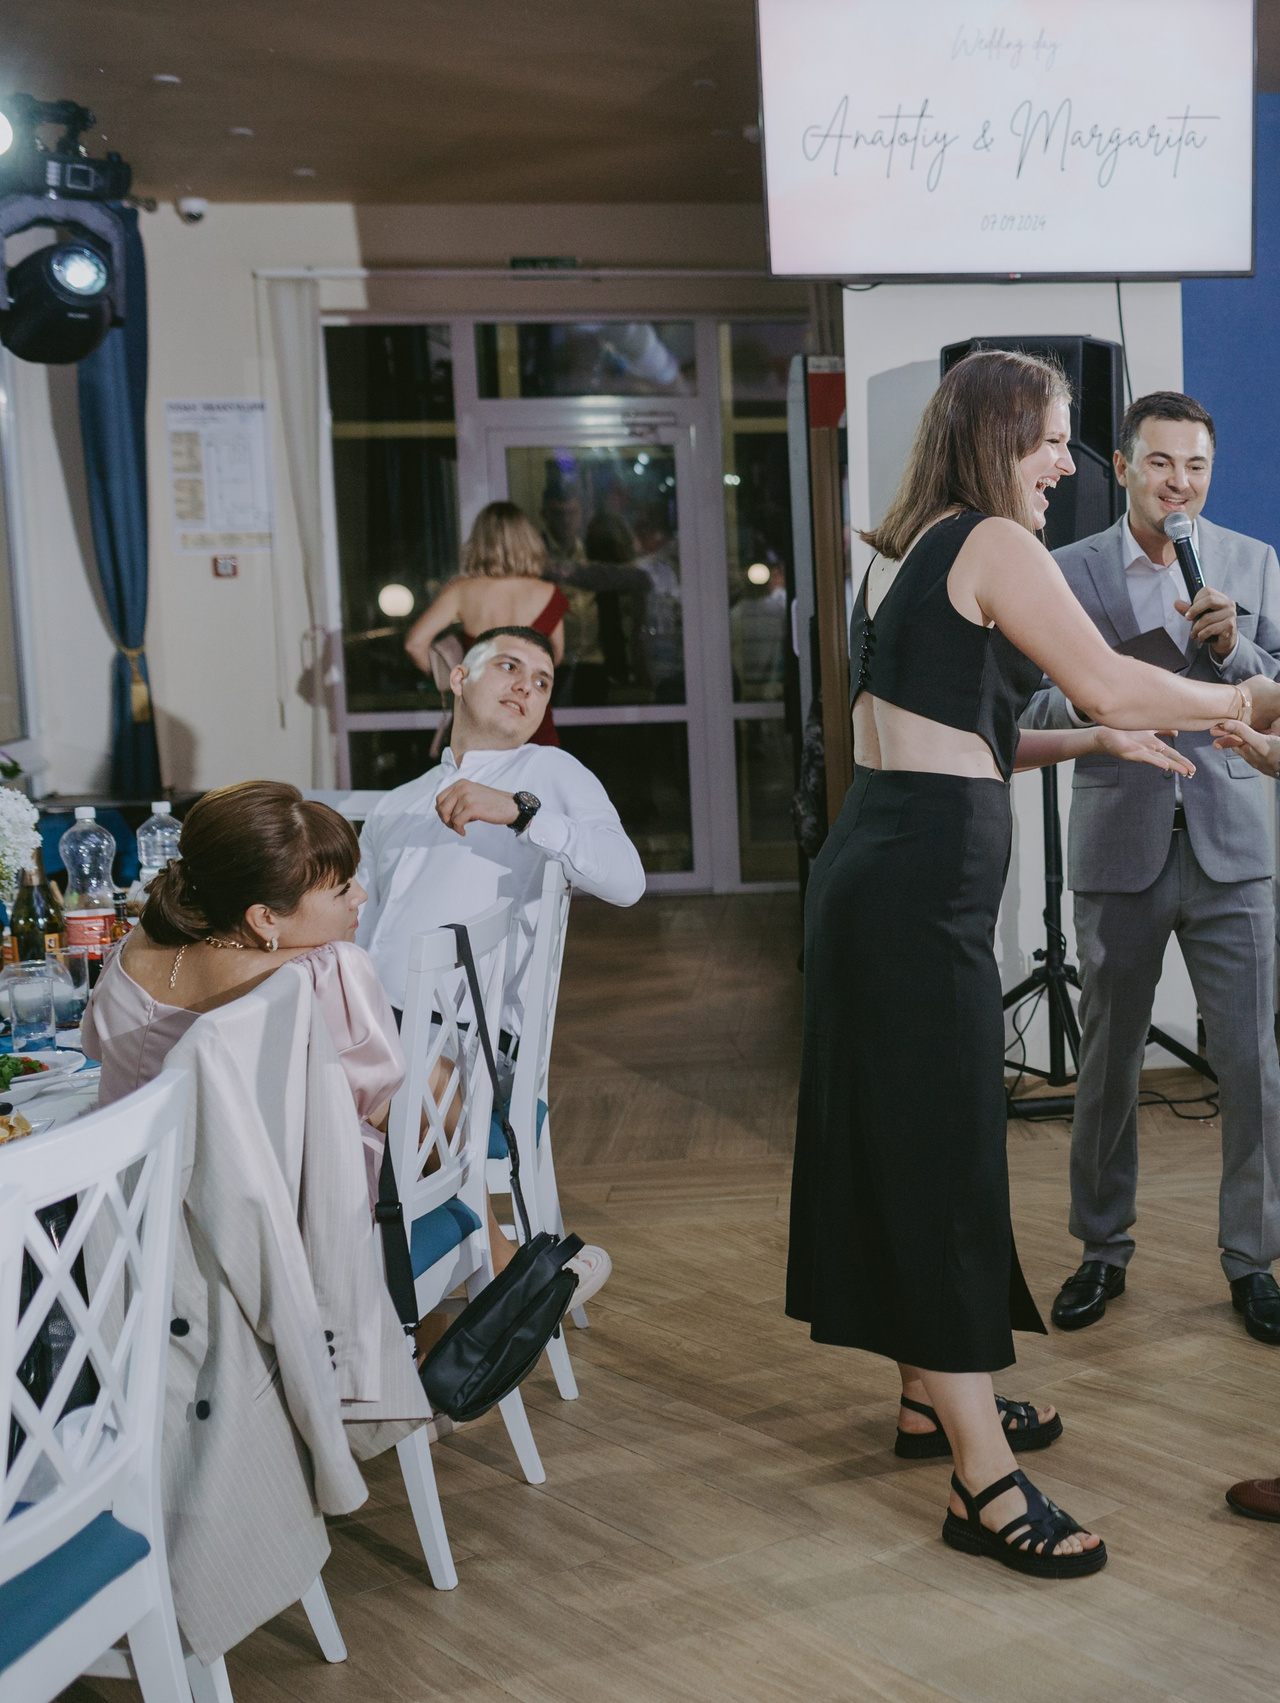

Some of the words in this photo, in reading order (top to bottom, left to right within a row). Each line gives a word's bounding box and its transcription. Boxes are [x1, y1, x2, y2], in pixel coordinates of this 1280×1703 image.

[950, 23, 1029, 70] Wedding
[1031, 27, 1063, 72] day
[973, 120, 994, 153] &
[1010, 98, 1221, 188] Margarita
